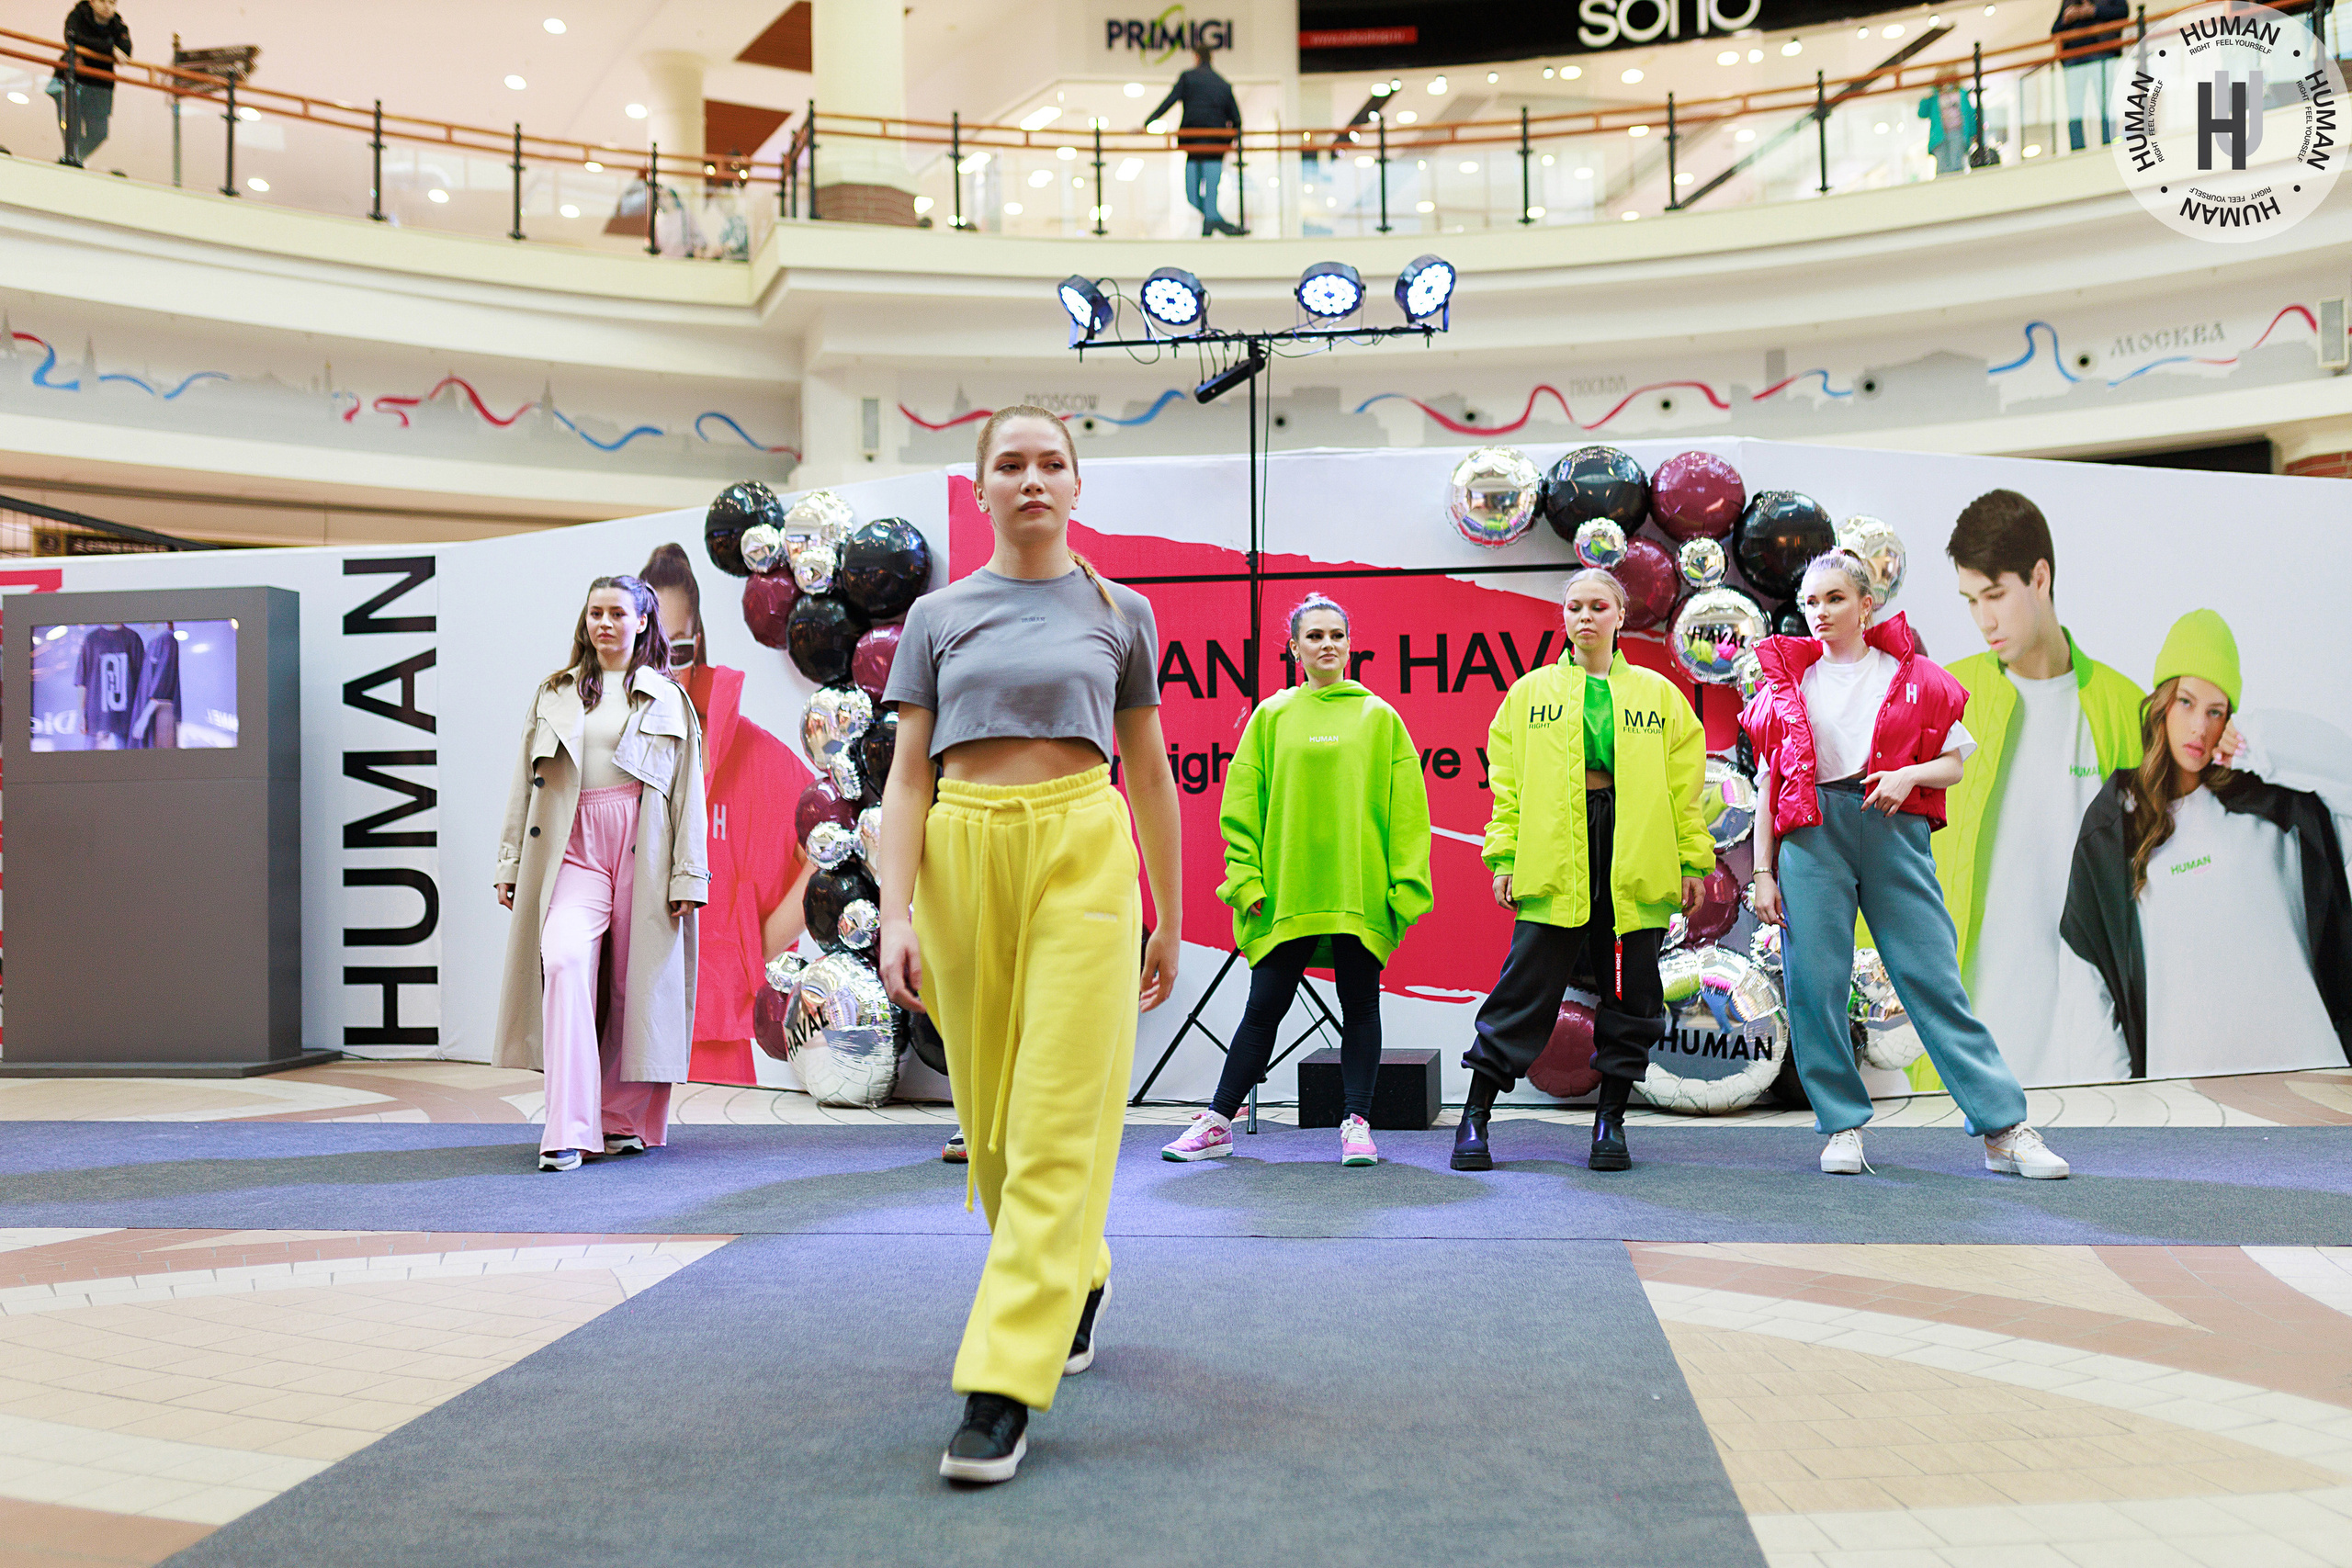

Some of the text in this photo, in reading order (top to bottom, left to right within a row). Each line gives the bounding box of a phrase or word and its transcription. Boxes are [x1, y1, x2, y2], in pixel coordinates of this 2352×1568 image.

[1105, 19, 1234, 51] PRIMIGI
[1690, 626, 1747, 649] HAVAL
[1529, 704, 1563, 723] HU
[1528, 722, 1551, 730] RIGHT
[1623, 726, 1641, 734] FEEL
[343, 555, 439, 1045] HUMAN
[2170, 854, 2211, 874] HUMAN
[785, 1006, 830, 1062] HAVAL
[1657, 1028, 1773, 1062] HUMAN
